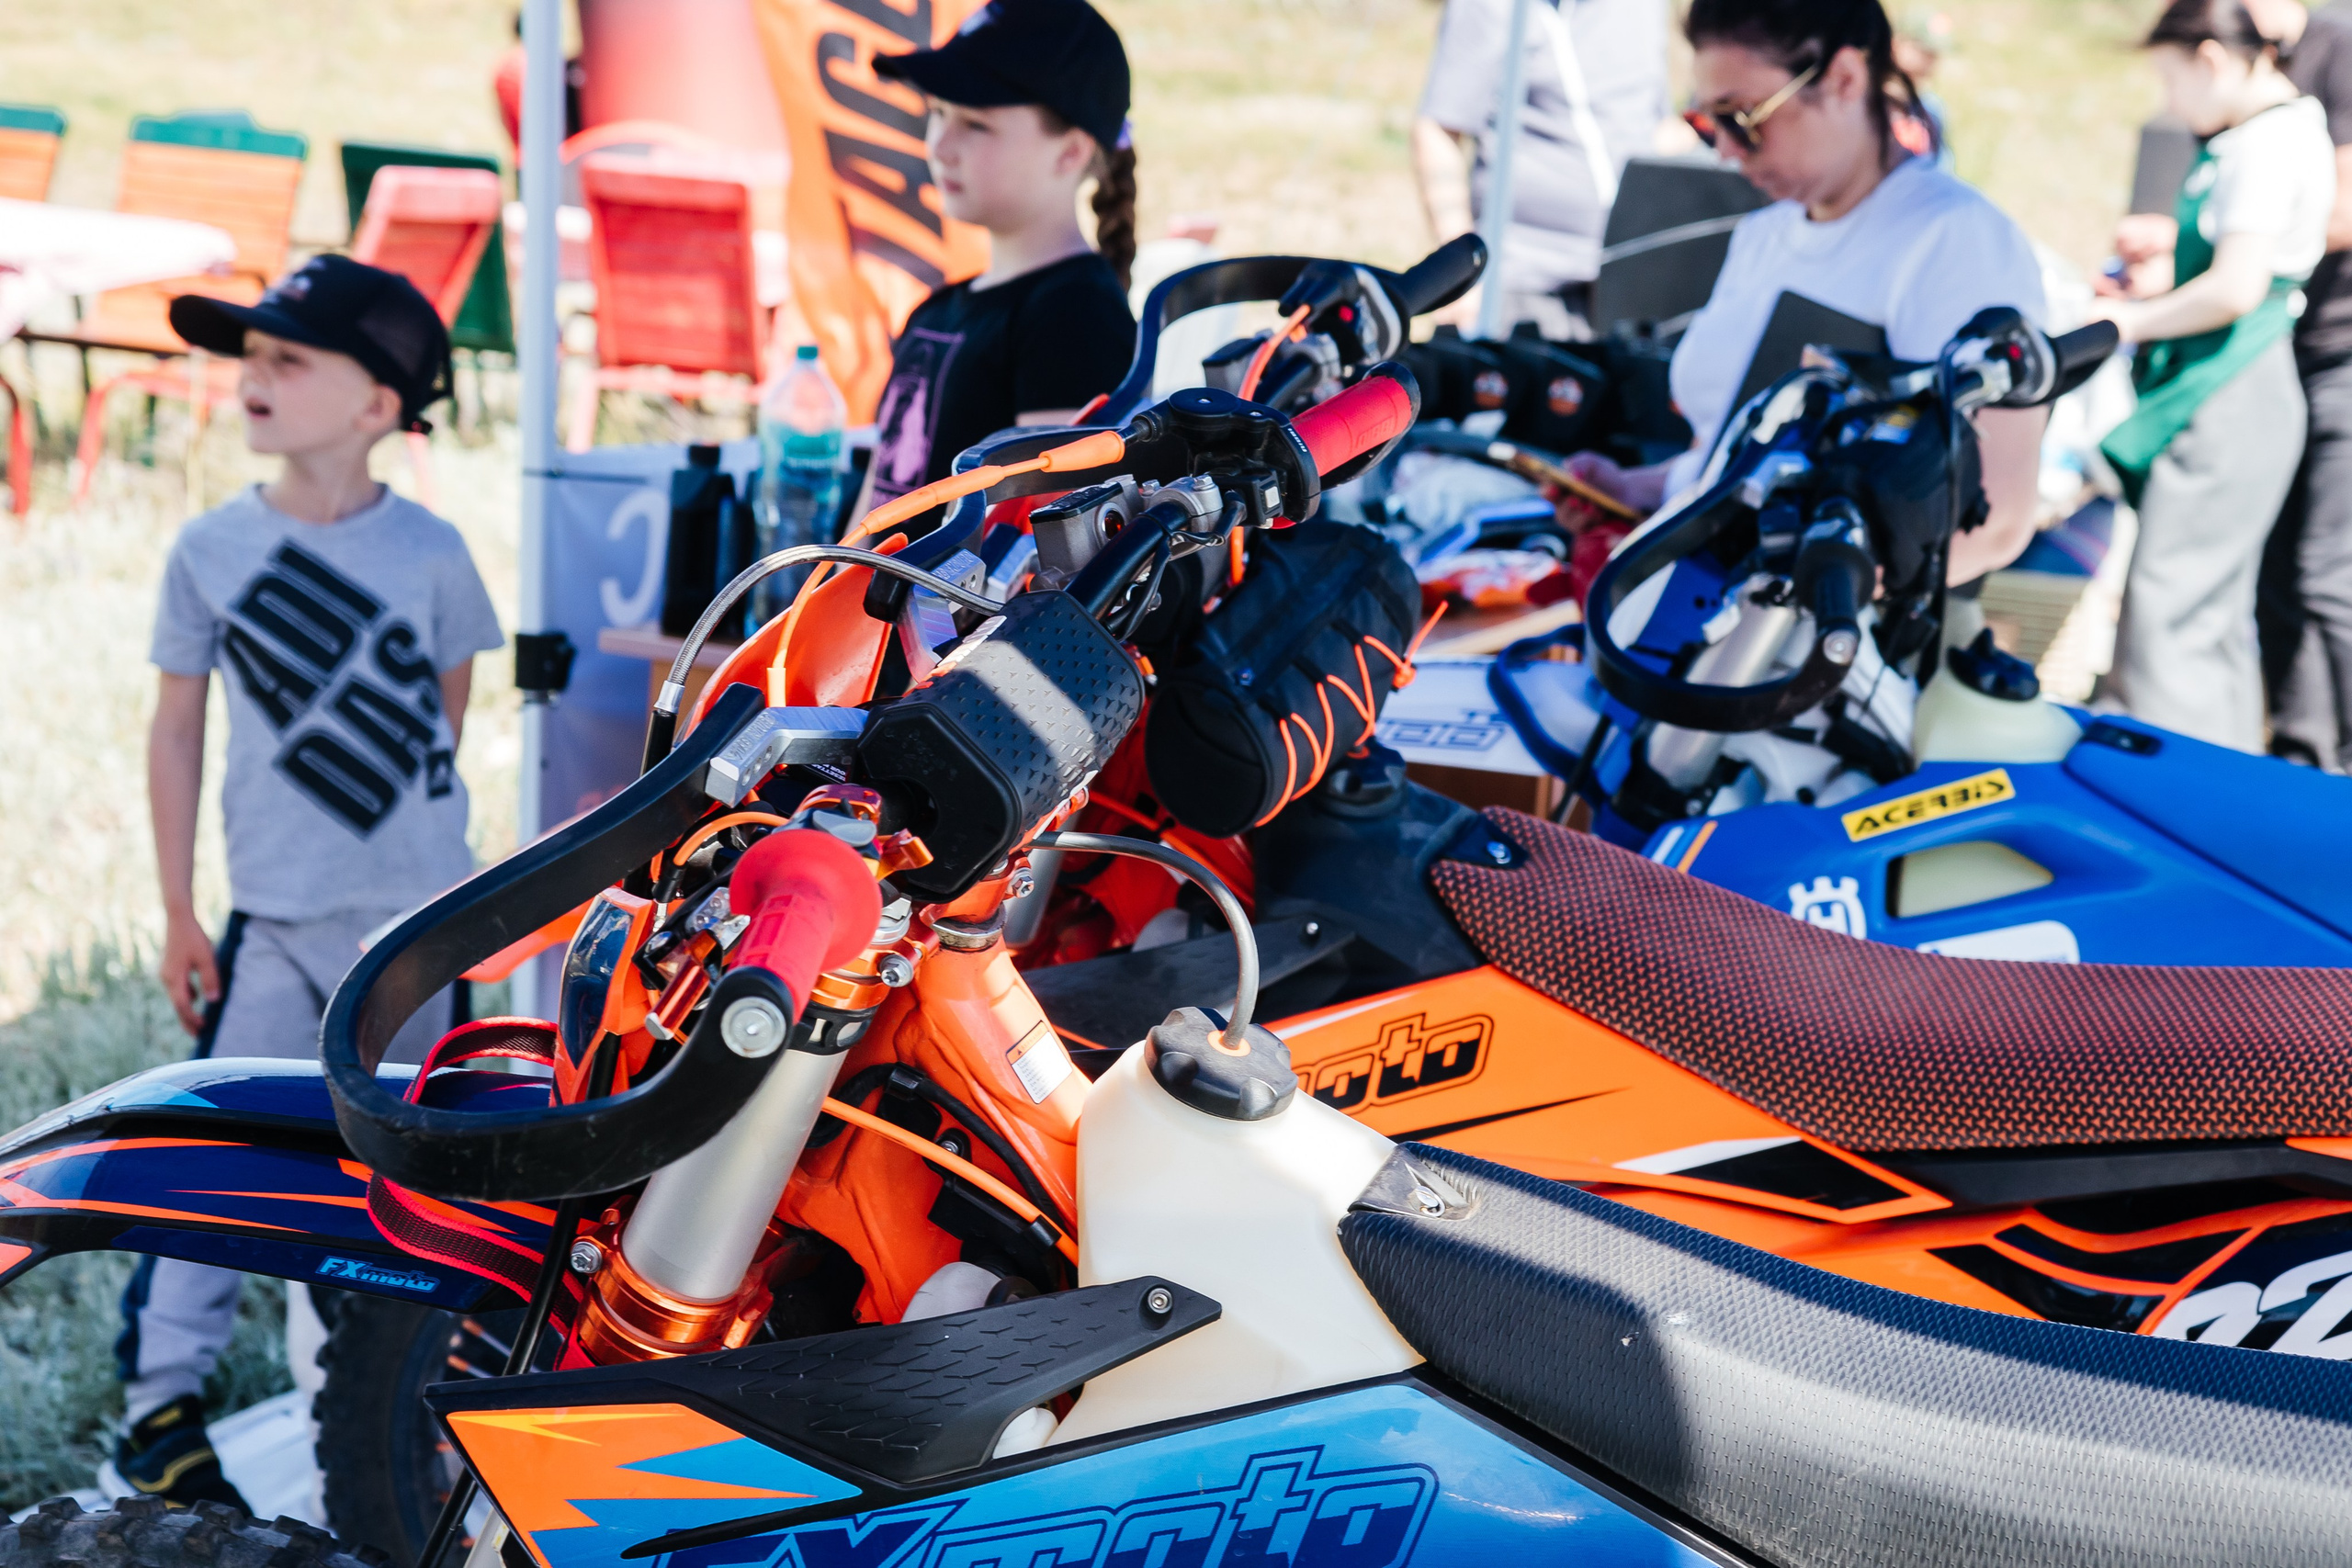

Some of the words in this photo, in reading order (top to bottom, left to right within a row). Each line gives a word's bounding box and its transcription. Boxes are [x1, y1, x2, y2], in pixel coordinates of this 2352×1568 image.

[1293, 1012, 1495, 1115] oto
[316, 1256, 441, 1292] FXmoto
[655, 1445, 1440, 1568] oto
